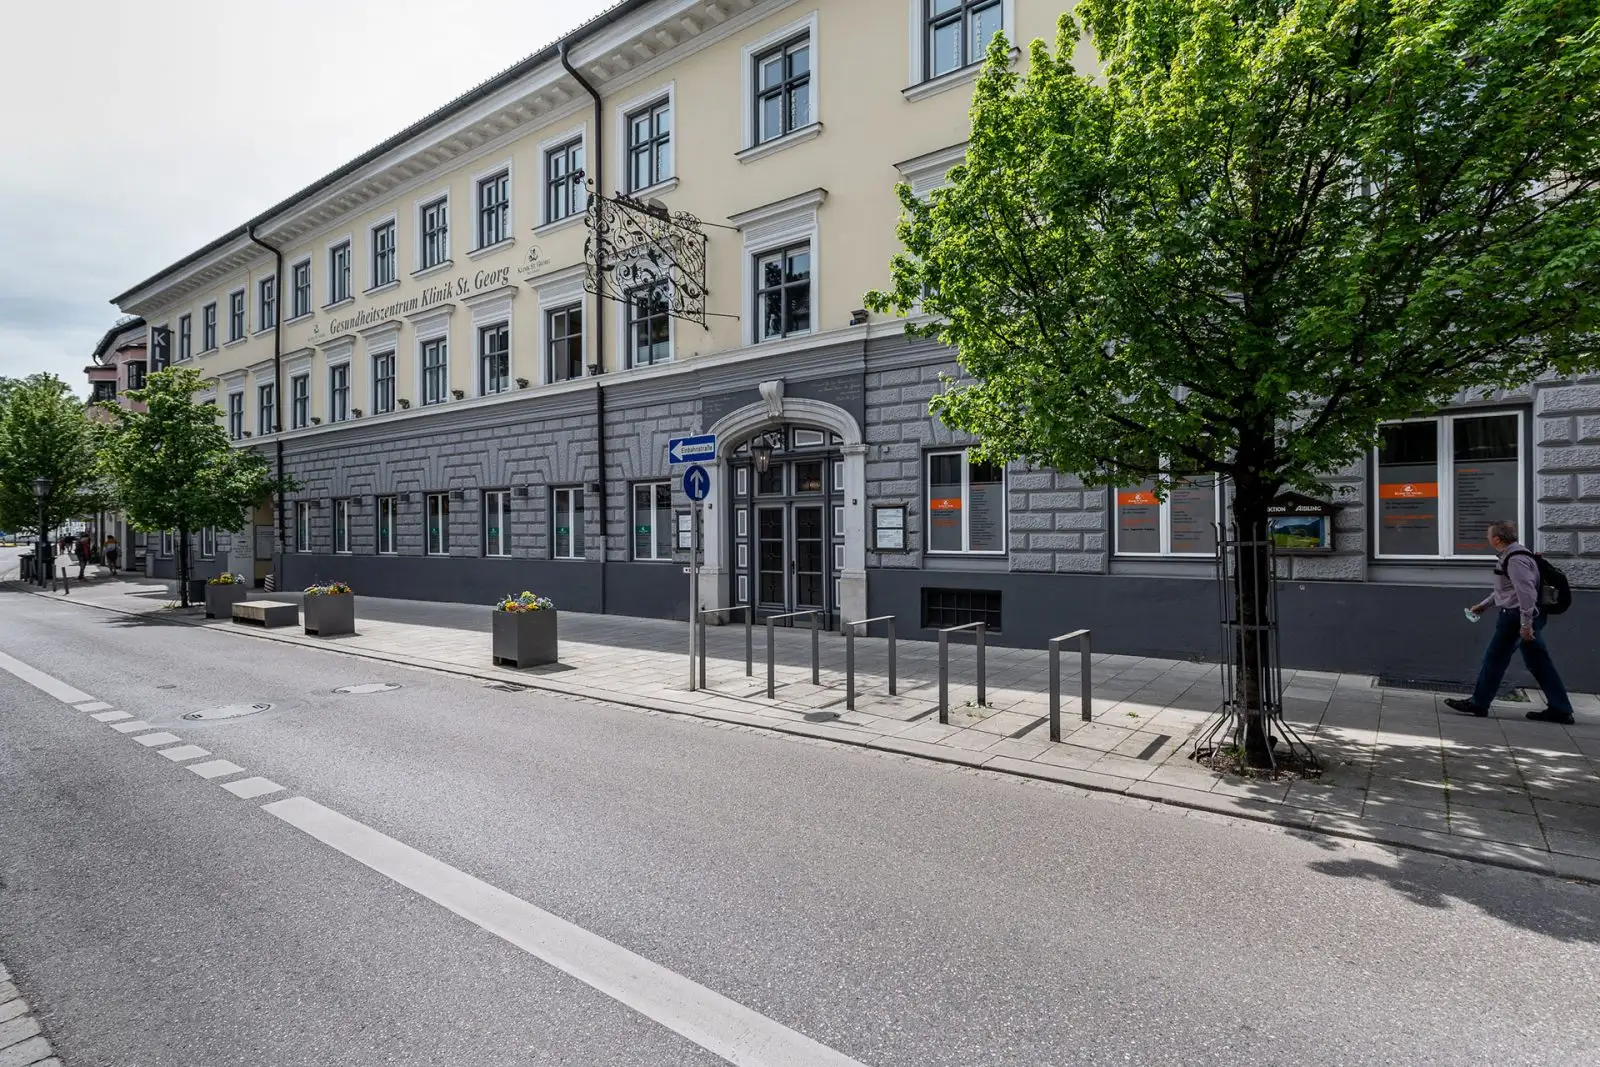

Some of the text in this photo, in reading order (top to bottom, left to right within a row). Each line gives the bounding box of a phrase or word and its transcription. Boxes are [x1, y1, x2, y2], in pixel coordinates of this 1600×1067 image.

[330, 266, 510, 335] Gesundheitszentrum Klinik St. Georg
[154, 331, 166, 373] KLI
